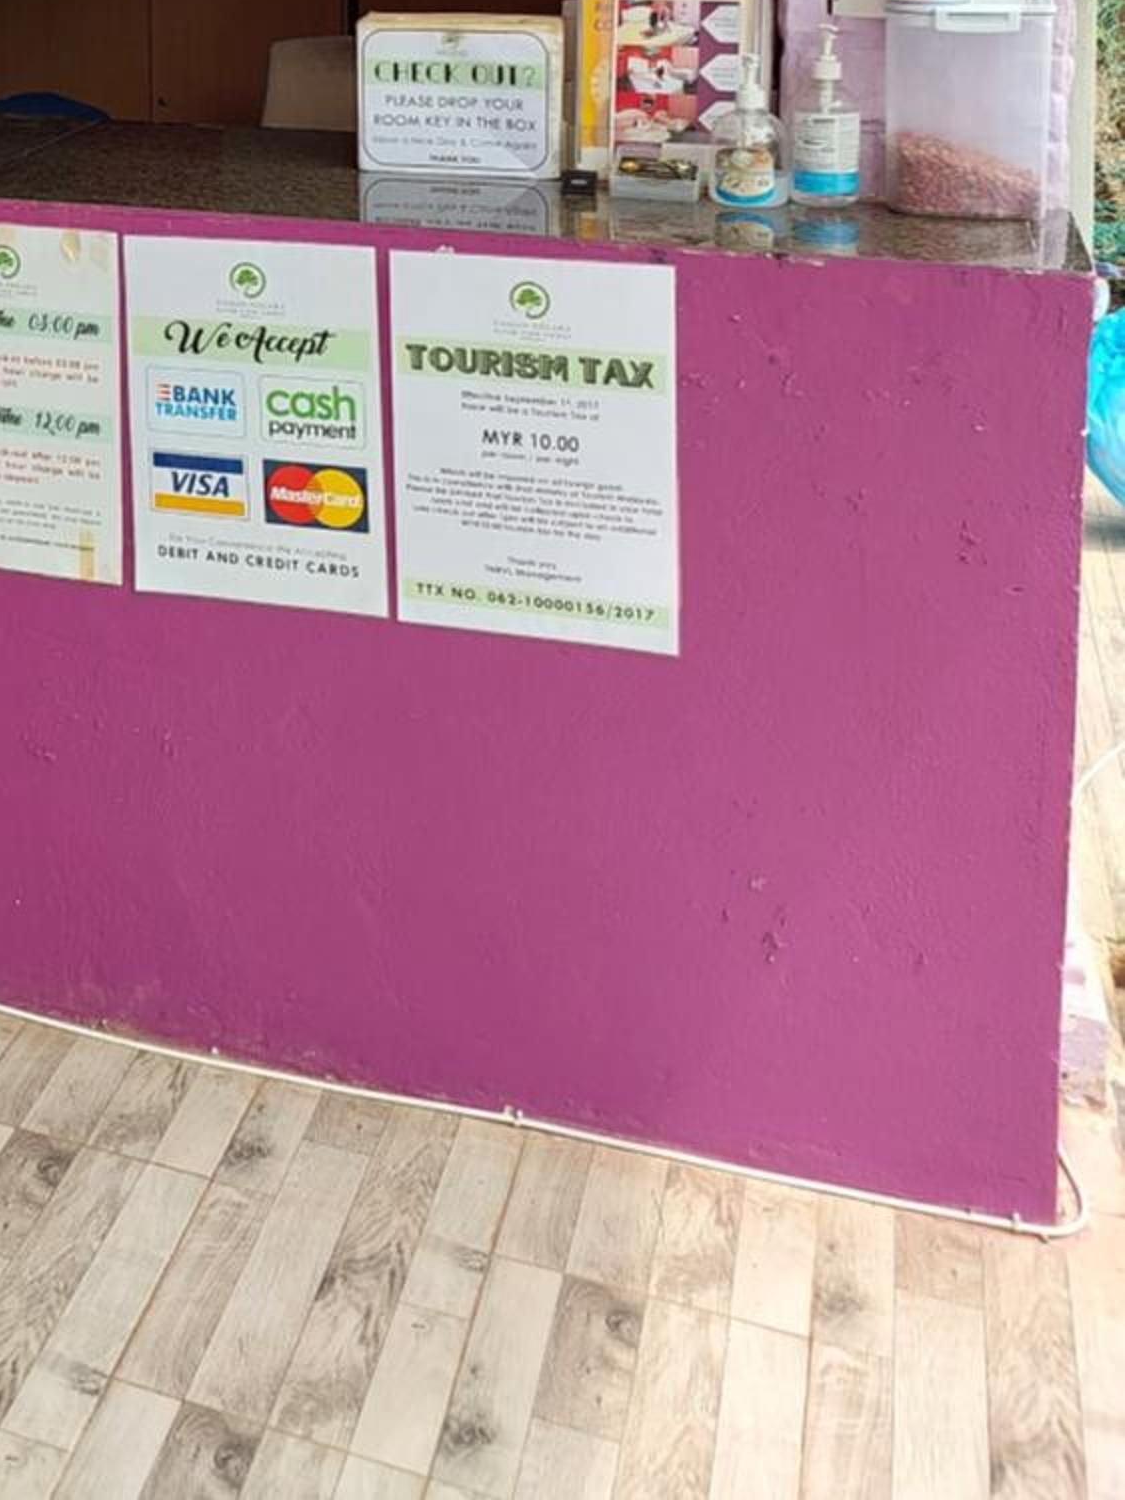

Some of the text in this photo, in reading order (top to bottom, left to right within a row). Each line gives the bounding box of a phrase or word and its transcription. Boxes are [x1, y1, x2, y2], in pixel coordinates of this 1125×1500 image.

[374, 61, 461, 83] CHECK
[385, 95, 524, 111] PLEASE DROP YOUR
[373, 114, 537, 131] ROOM KEY IN THE BOX
[74, 320, 100, 340] pm
[164, 320, 338, 364] We Accept
[405, 343, 655, 389] TOURISM TAX
[155, 401, 237, 421] TRANSFER
[265, 385, 357, 421] cash
[76, 421, 101, 439] pm
[268, 419, 357, 440] payment
[482, 428, 580, 452] MYR 10.00
[171, 470, 230, 498] VISA
[157, 544, 360, 578] DEBIT AND CREDIT CARDS
[416, 582, 444, 597] TTX
[487, 590, 655, 622] 062-10000156/2017
